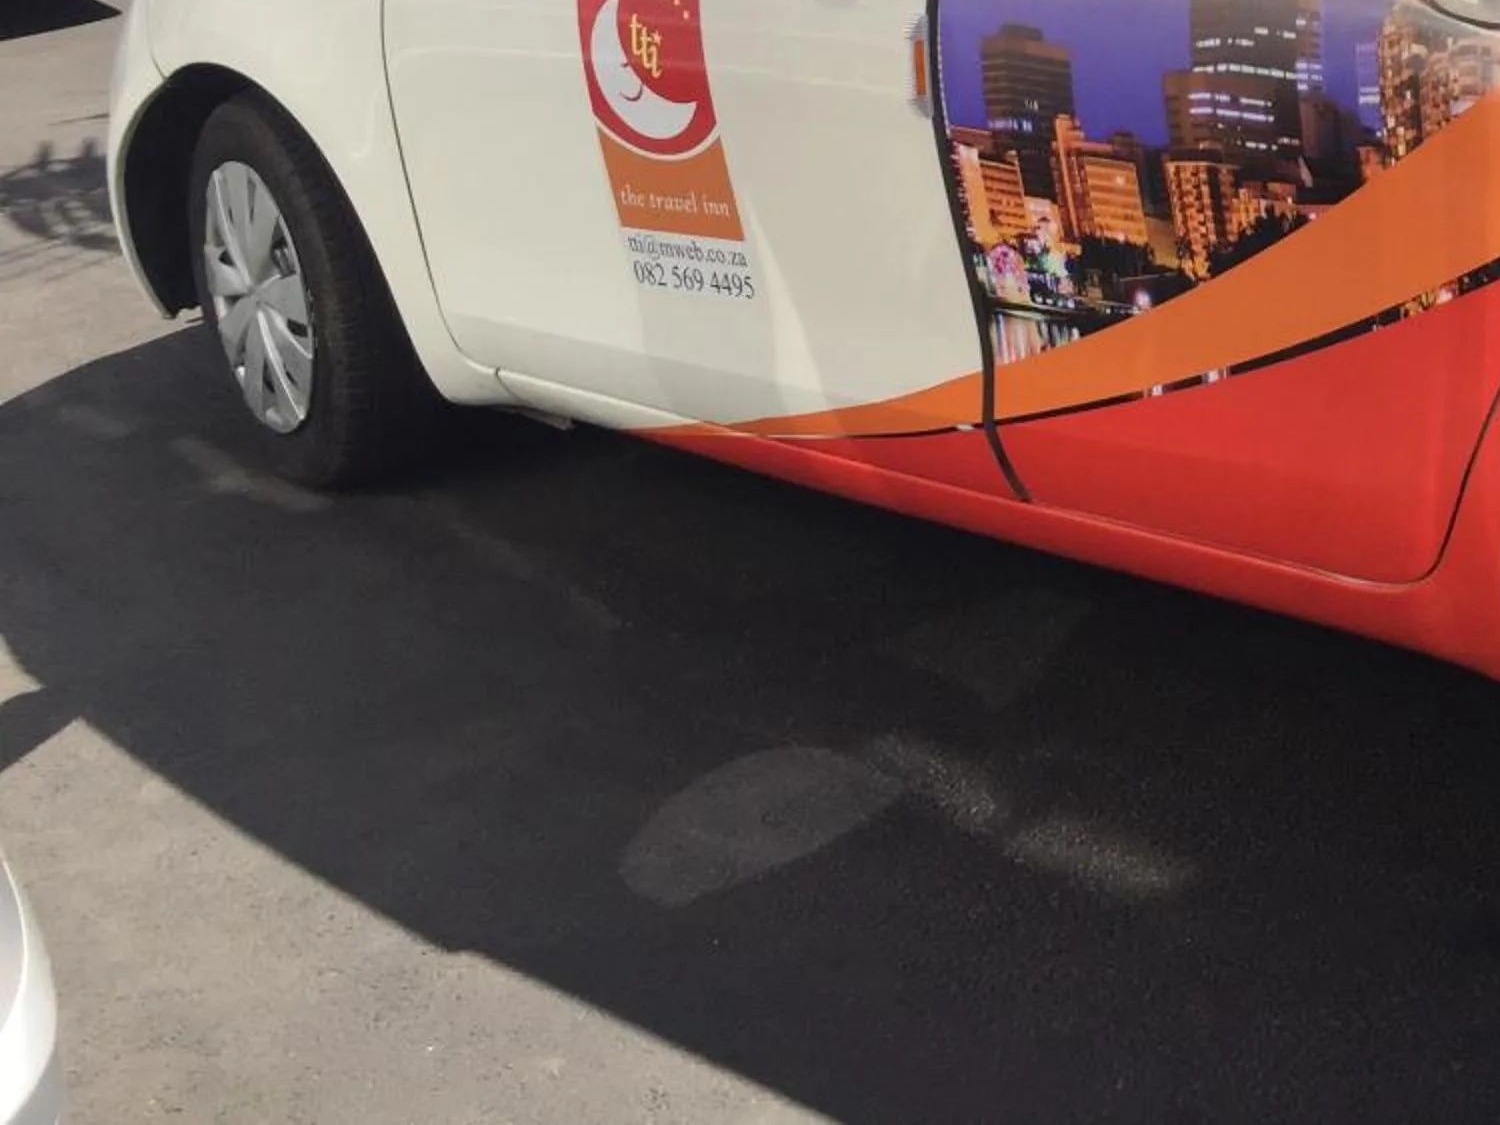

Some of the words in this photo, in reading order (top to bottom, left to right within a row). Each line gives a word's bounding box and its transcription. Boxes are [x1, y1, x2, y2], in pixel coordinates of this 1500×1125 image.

[621, 183, 645, 208] the
[649, 191, 697, 213] travel
[702, 193, 730, 218] inn
[633, 260, 667, 286] 082
[671, 266, 704, 292] 569
[709, 271, 755, 299] 4495
